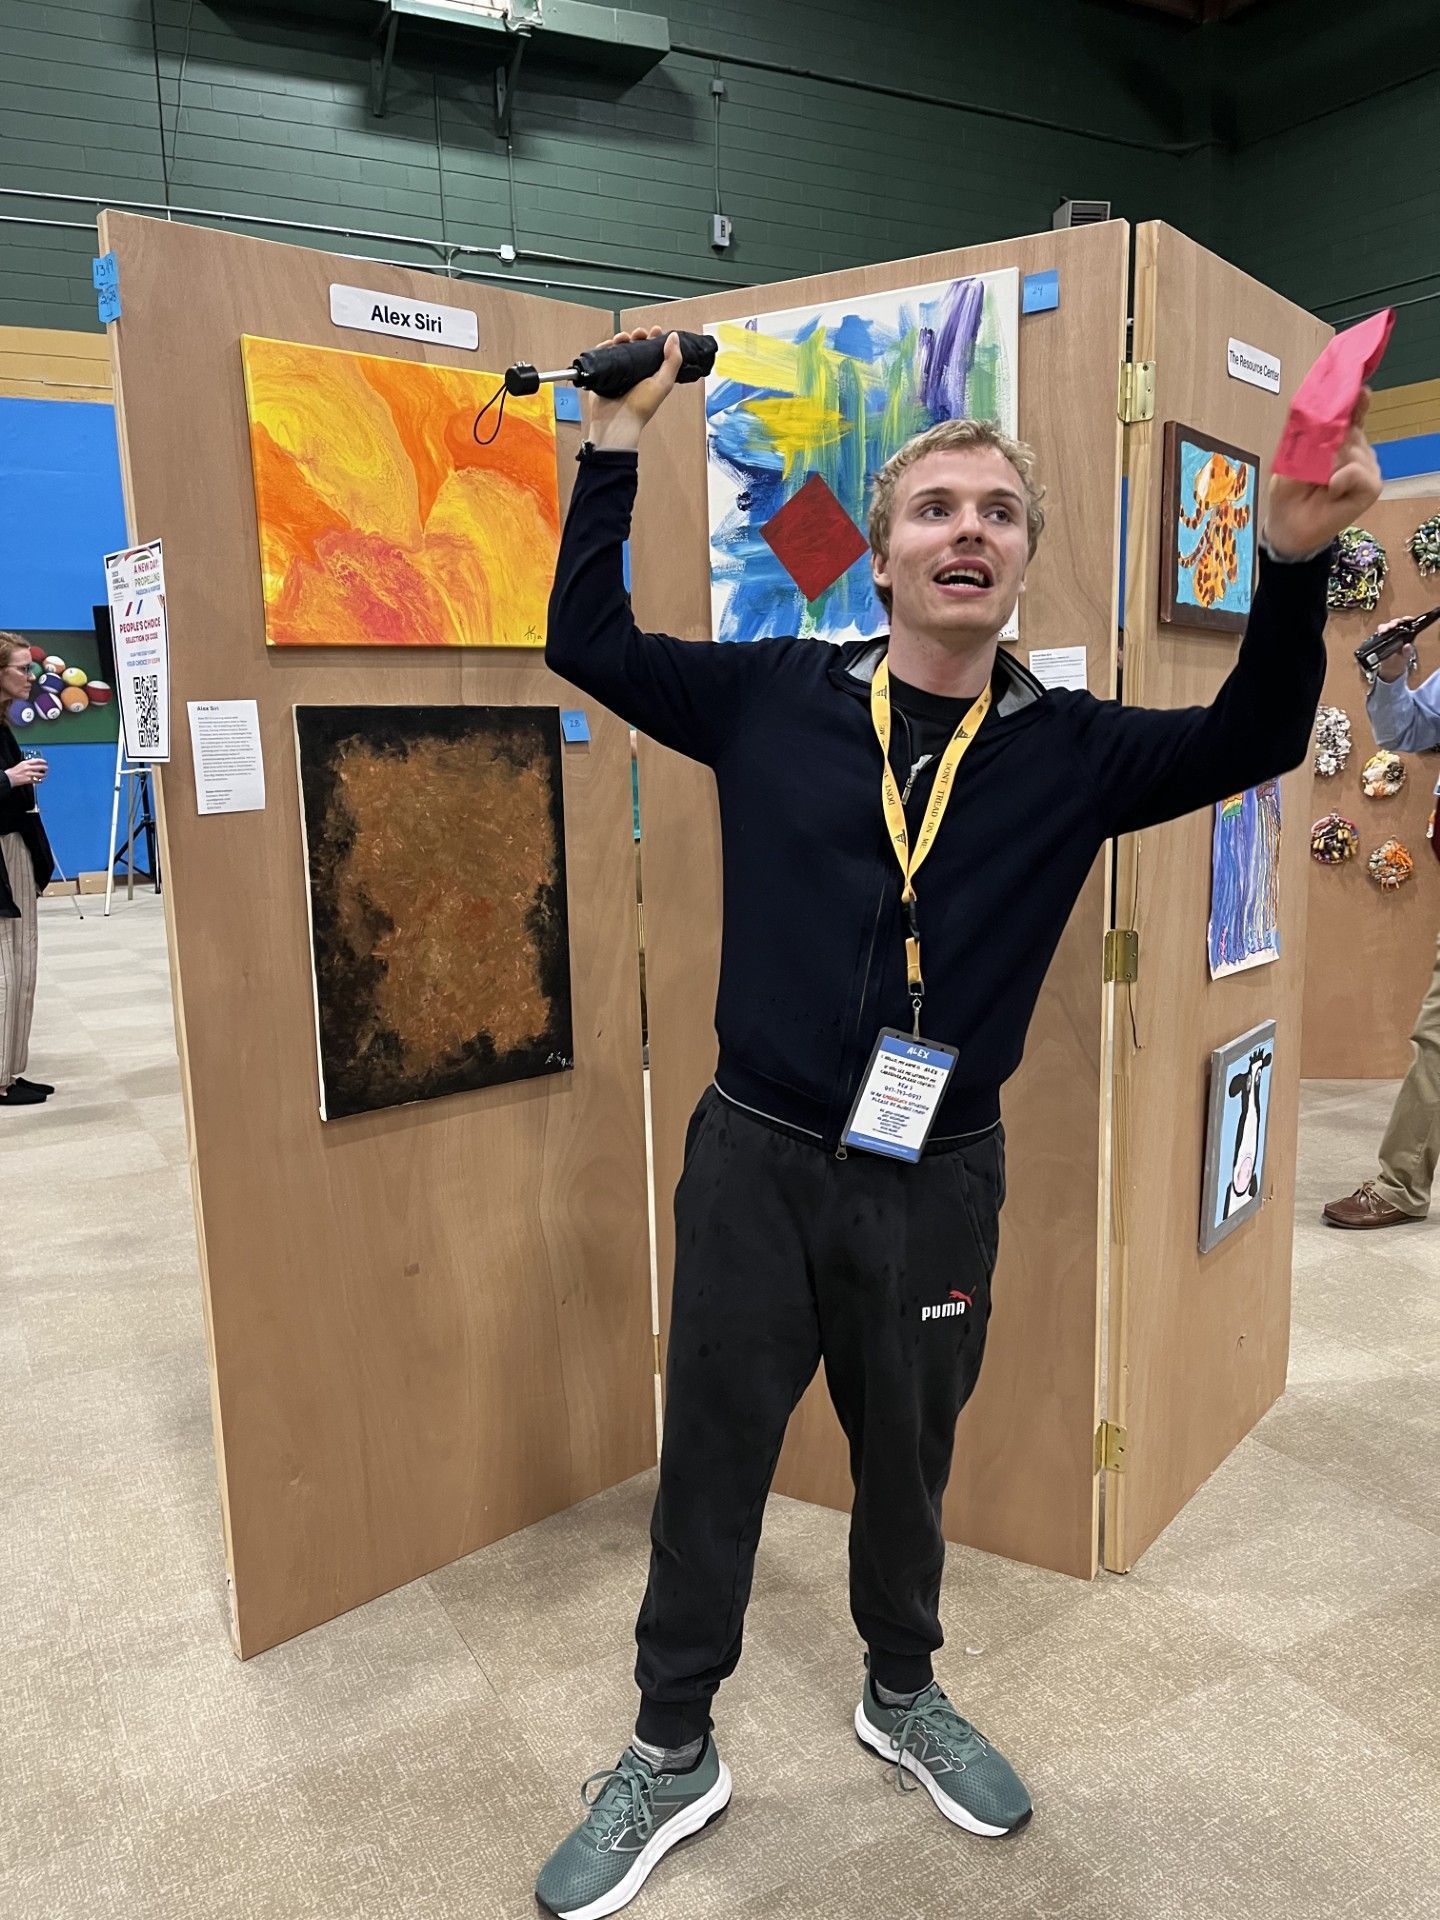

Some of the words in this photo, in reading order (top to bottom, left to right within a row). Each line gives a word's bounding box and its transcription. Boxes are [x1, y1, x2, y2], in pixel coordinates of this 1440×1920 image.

[371, 305, 411, 328] Alex
[415, 313, 442, 333] Siri
[1230, 350, 1239, 365] The
[1240, 355, 1263, 375] Resource
[1264, 365, 1280, 381] Center
[138, 560, 149, 572] NEW
[144, 617, 161, 629] CHOICE
[932, 790, 944, 818] TREAD
[926, 822, 935, 833] ON
[920, 838, 929, 849] ME
[907, 1046, 930, 1060] ALEX
[923, 1067, 938, 1075] ALEX
[872, 1097, 889, 1106] PLEASE
[882, 1094, 907, 1104] EMERGENCY
[921, 1301, 966, 1321] PUMA
